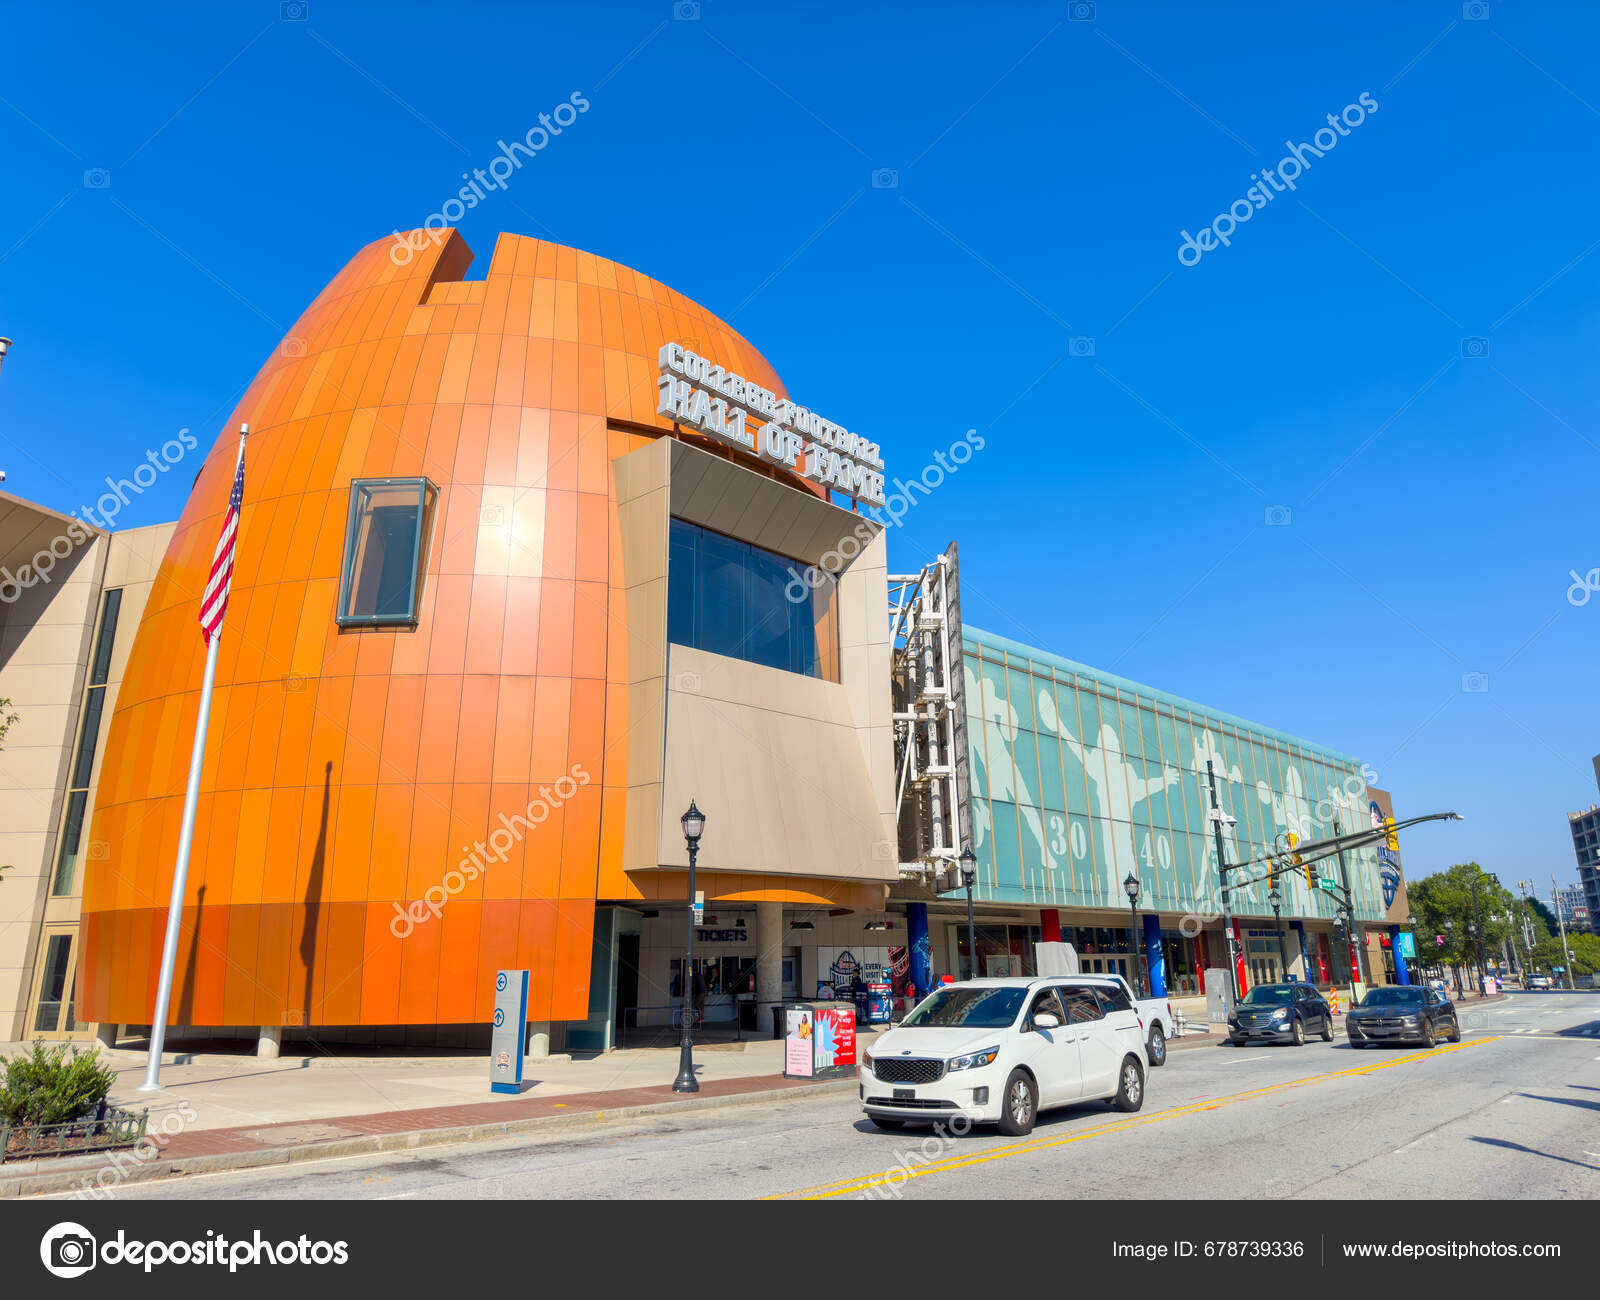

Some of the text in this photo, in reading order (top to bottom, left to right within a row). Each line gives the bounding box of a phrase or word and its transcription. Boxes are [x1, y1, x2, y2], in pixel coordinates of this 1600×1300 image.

[659, 342, 884, 471] COLLEGE FOOTBALL
[658, 374, 886, 507] HALL OF FAME
[1050, 815, 1087, 860] 30
[1140, 832, 1171, 870] 40
[697, 929, 748, 942] TICKETS
